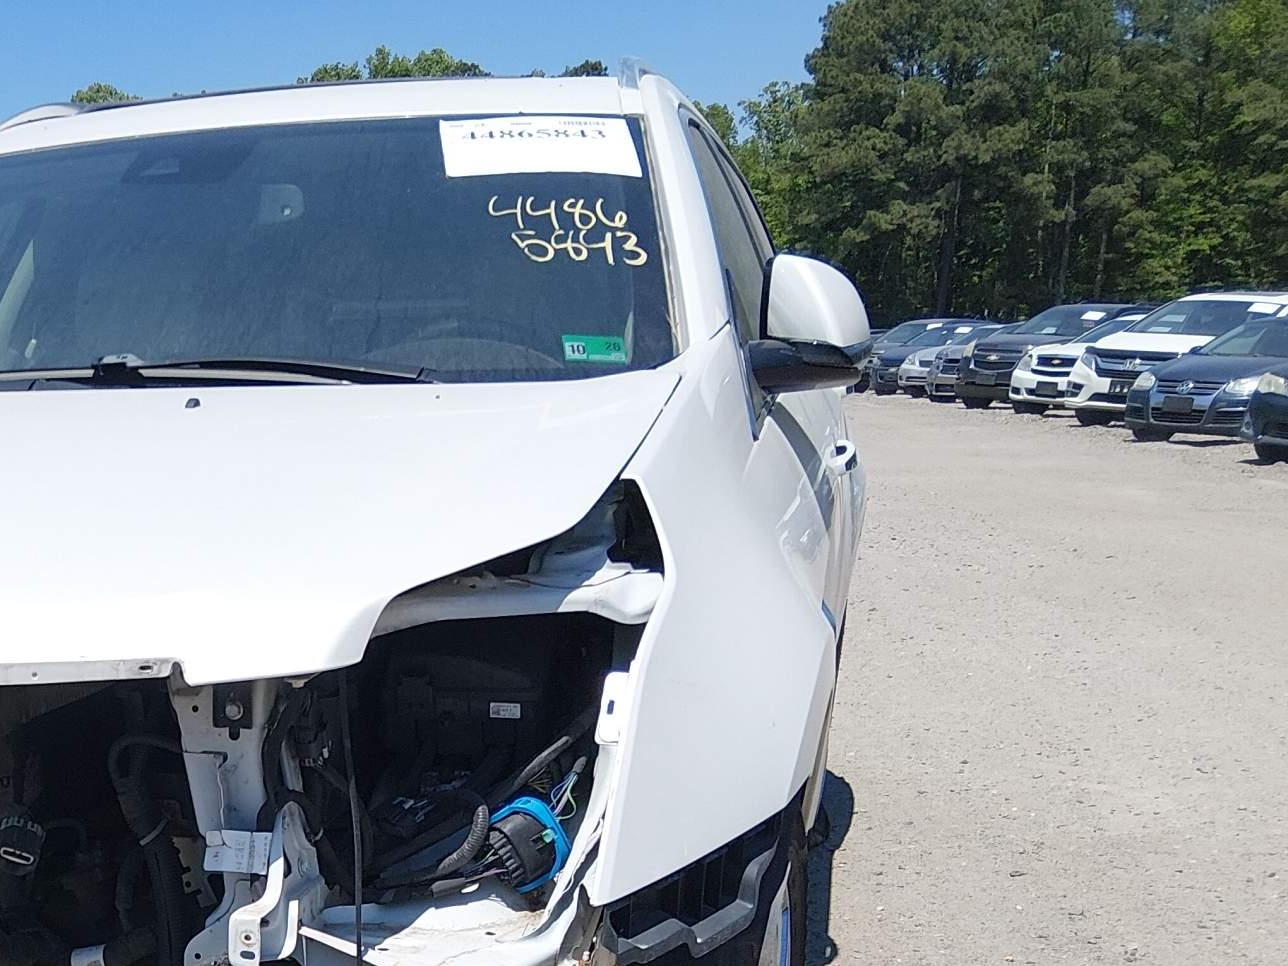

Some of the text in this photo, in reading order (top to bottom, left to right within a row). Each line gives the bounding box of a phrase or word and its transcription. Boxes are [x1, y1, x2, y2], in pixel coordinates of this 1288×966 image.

[488, 194, 628, 230] 4486
[510, 229, 648, 266] 5843
[568, 343, 586, 356] 10
